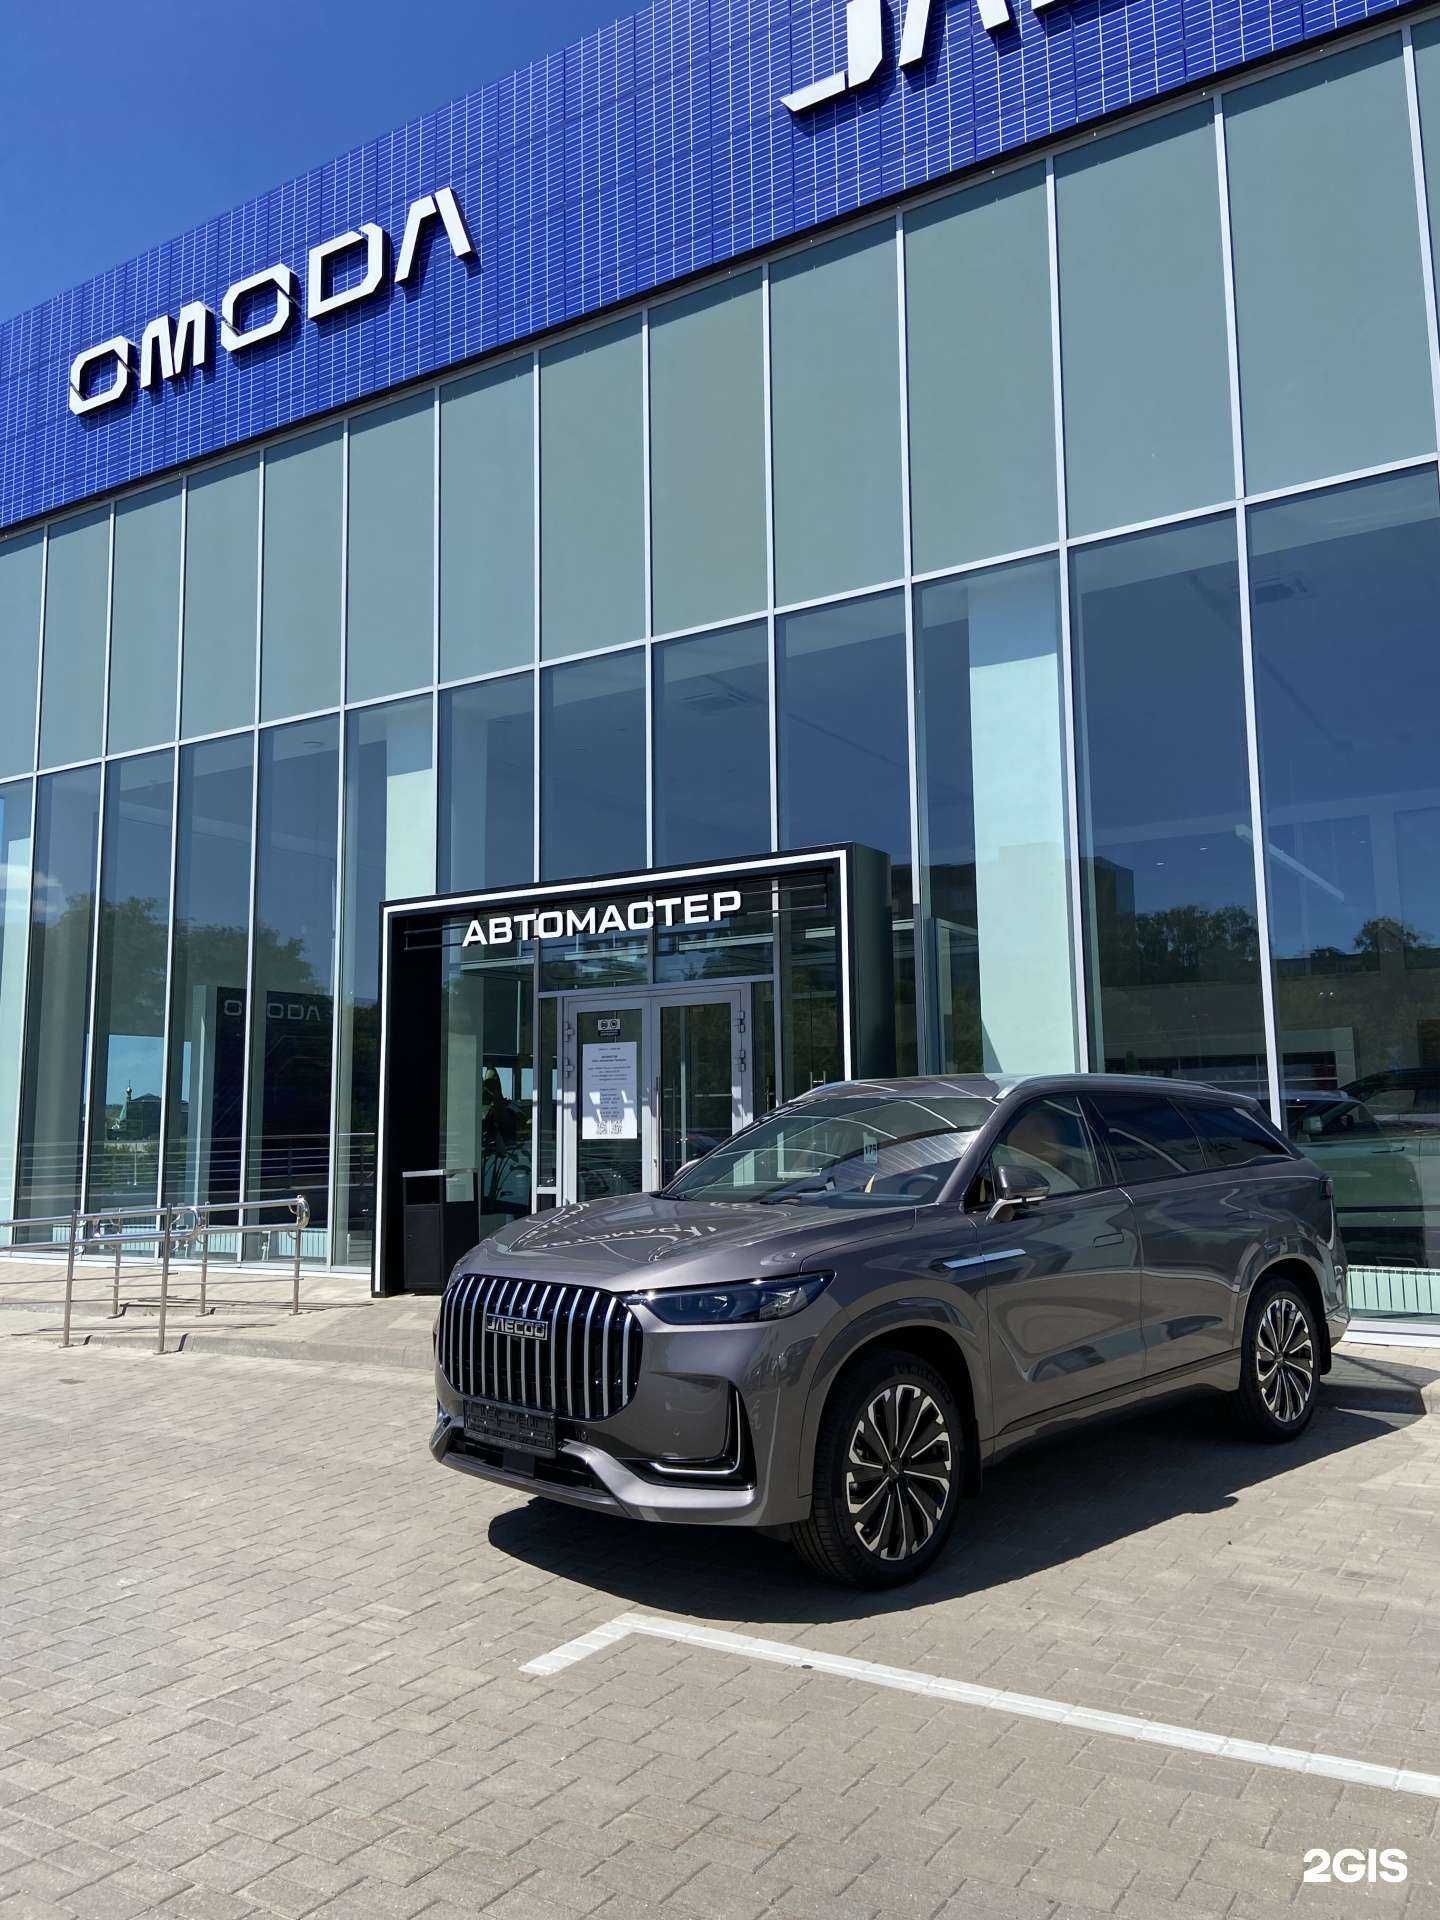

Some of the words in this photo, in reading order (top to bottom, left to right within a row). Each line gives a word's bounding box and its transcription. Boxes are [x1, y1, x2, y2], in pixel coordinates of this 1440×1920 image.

[69, 187, 475, 416] OMODA
[462, 890, 742, 948] АВТОМАСТЕР
[224, 1000, 321, 1021] OODA
[487, 1317, 545, 1337] JAECOO
